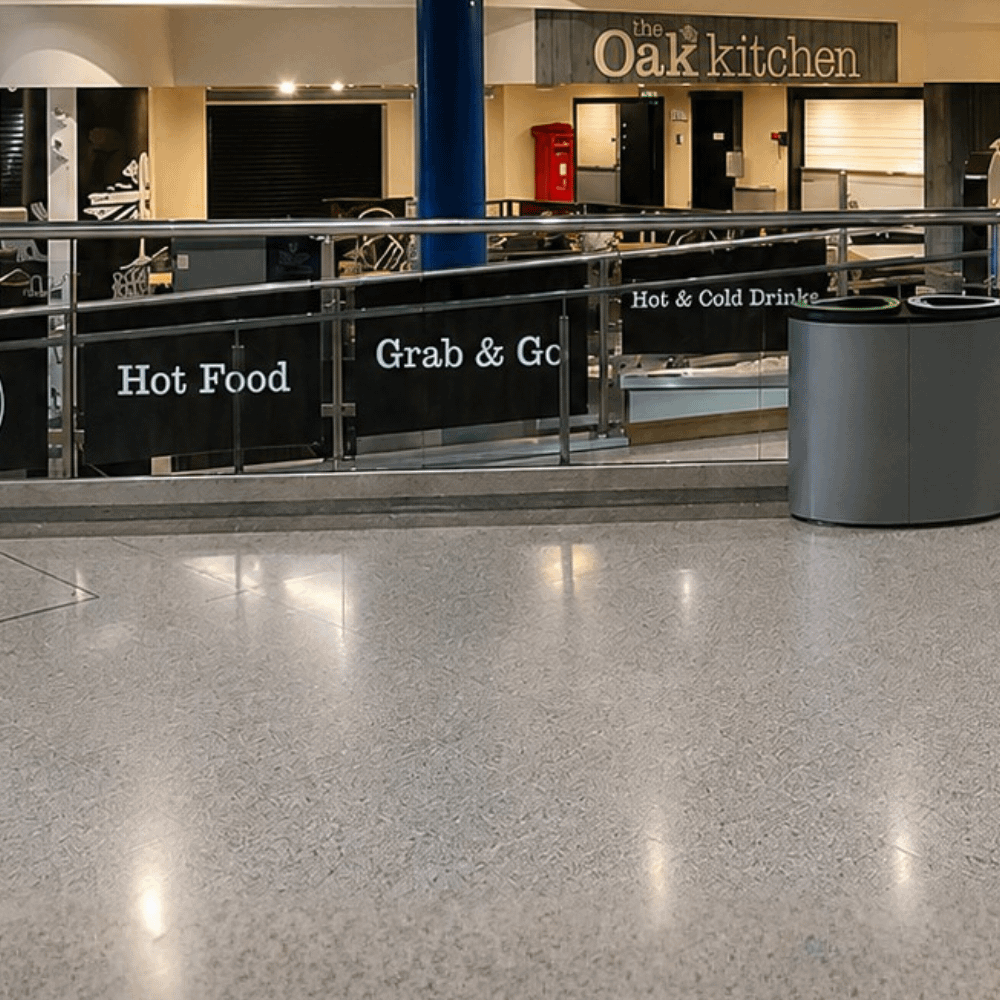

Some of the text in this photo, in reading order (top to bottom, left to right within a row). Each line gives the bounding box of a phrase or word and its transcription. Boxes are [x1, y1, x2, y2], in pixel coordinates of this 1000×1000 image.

[633, 19, 664, 38] the
[593, 28, 861, 78] Oak kitchen
[630, 290, 669, 309] Hot
[675, 289, 692, 308] &
[699, 288, 744, 307] Cold
[376, 335, 562, 369] Grab & Go
[117, 360, 292, 396] Hot Food
